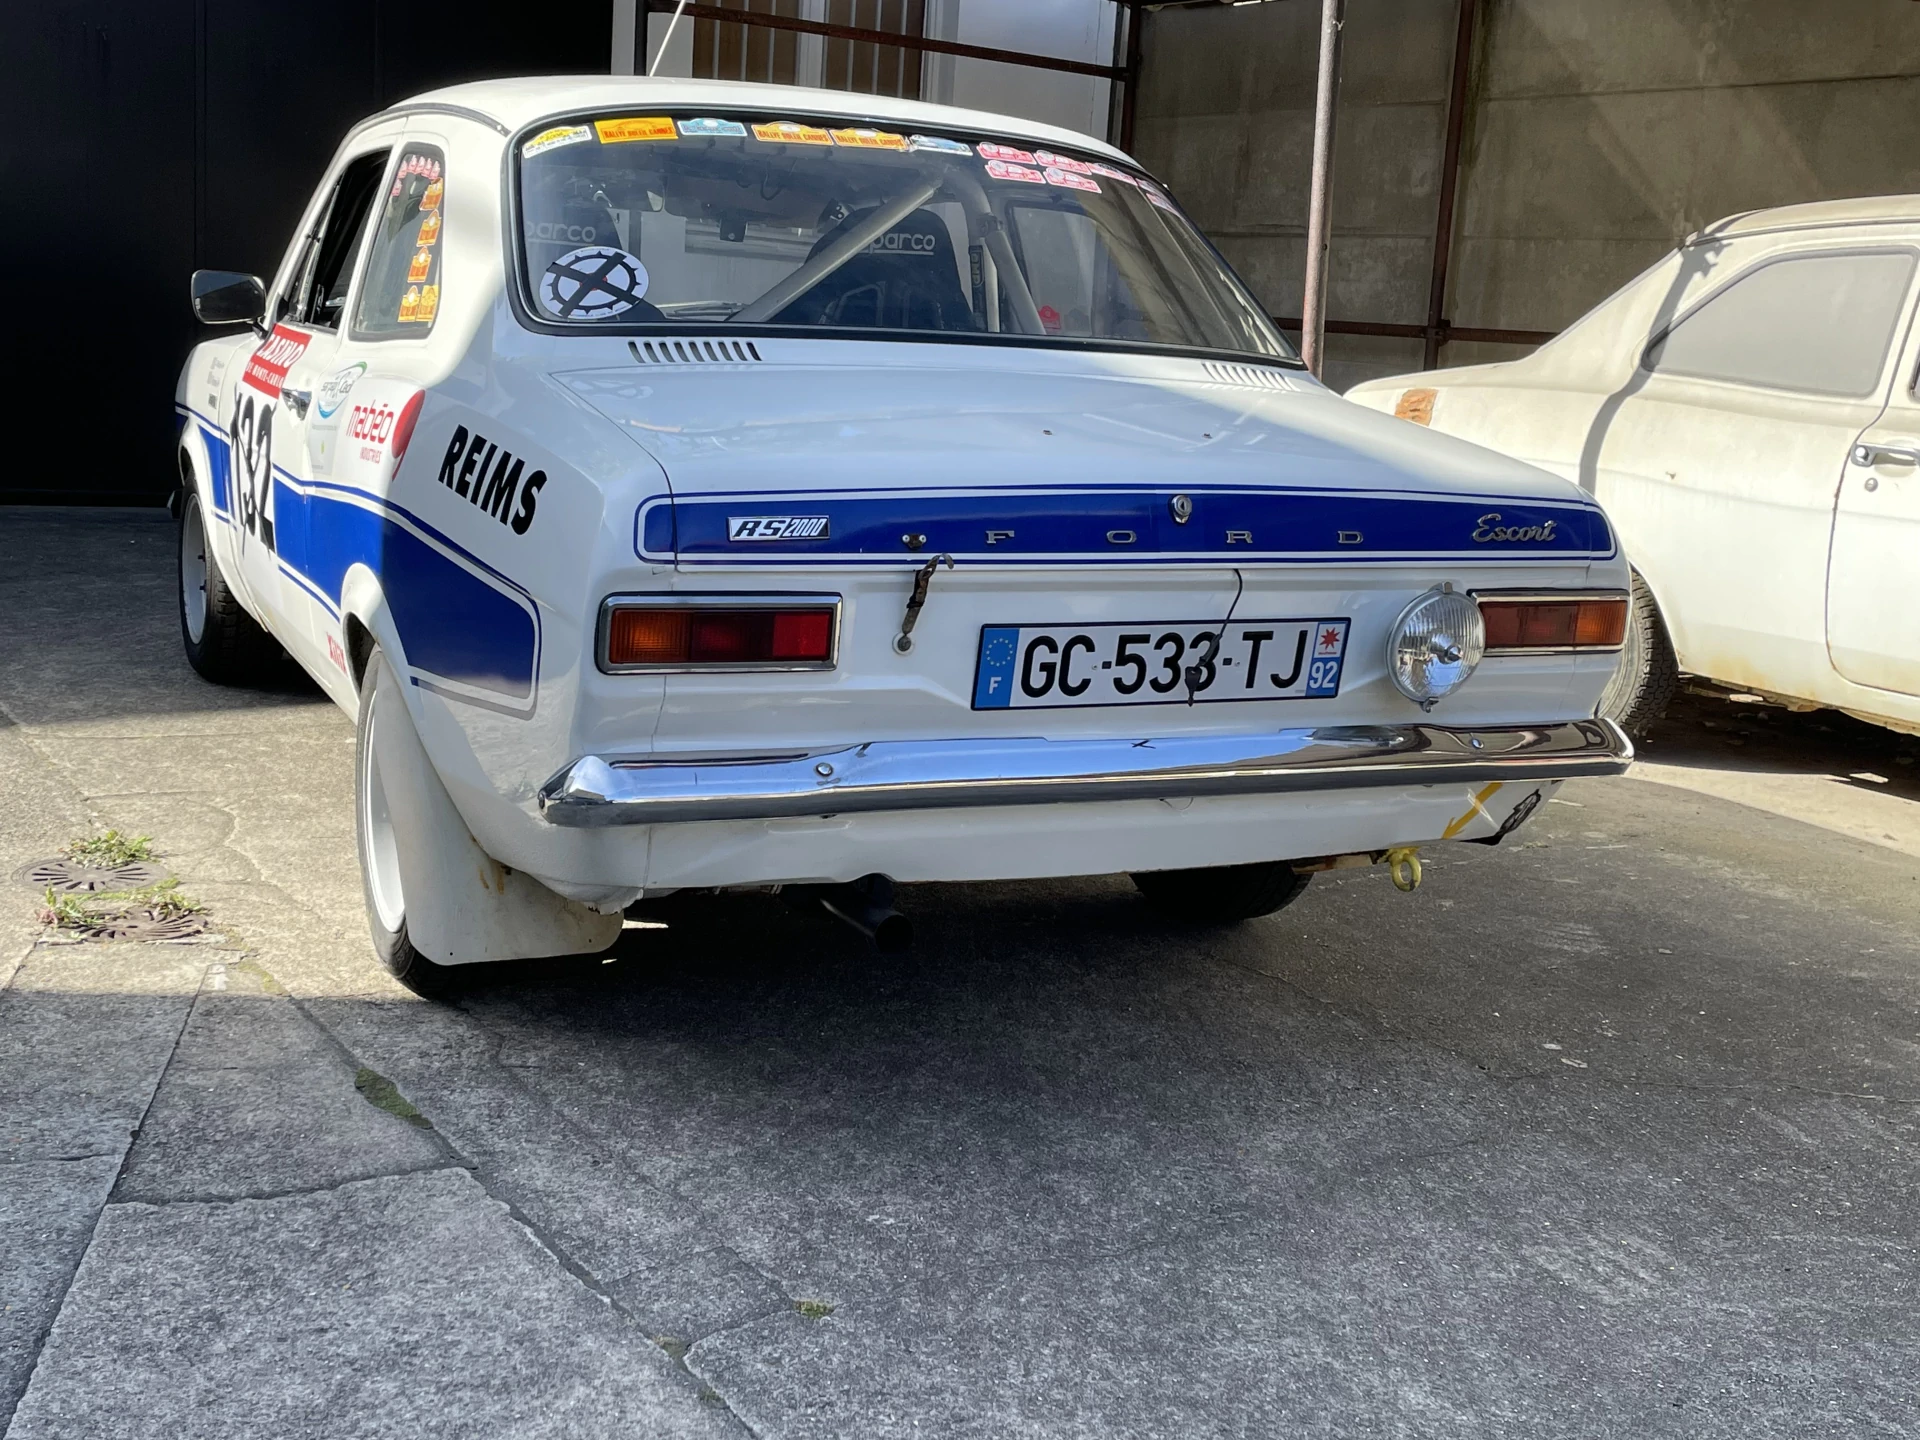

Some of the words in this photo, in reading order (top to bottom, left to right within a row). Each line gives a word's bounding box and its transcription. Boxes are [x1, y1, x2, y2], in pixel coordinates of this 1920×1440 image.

[525, 220, 597, 243] parco
[869, 233, 936, 255] parco
[255, 333, 306, 369] CASINO
[438, 424, 548, 536] REIMS
[1472, 513, 1557, 543] Escort
[988, 676, 1002, 694] F
[1020, 630, 1309, 698] GC-533-TJ
[1309, 660, 1338, 689] 92
